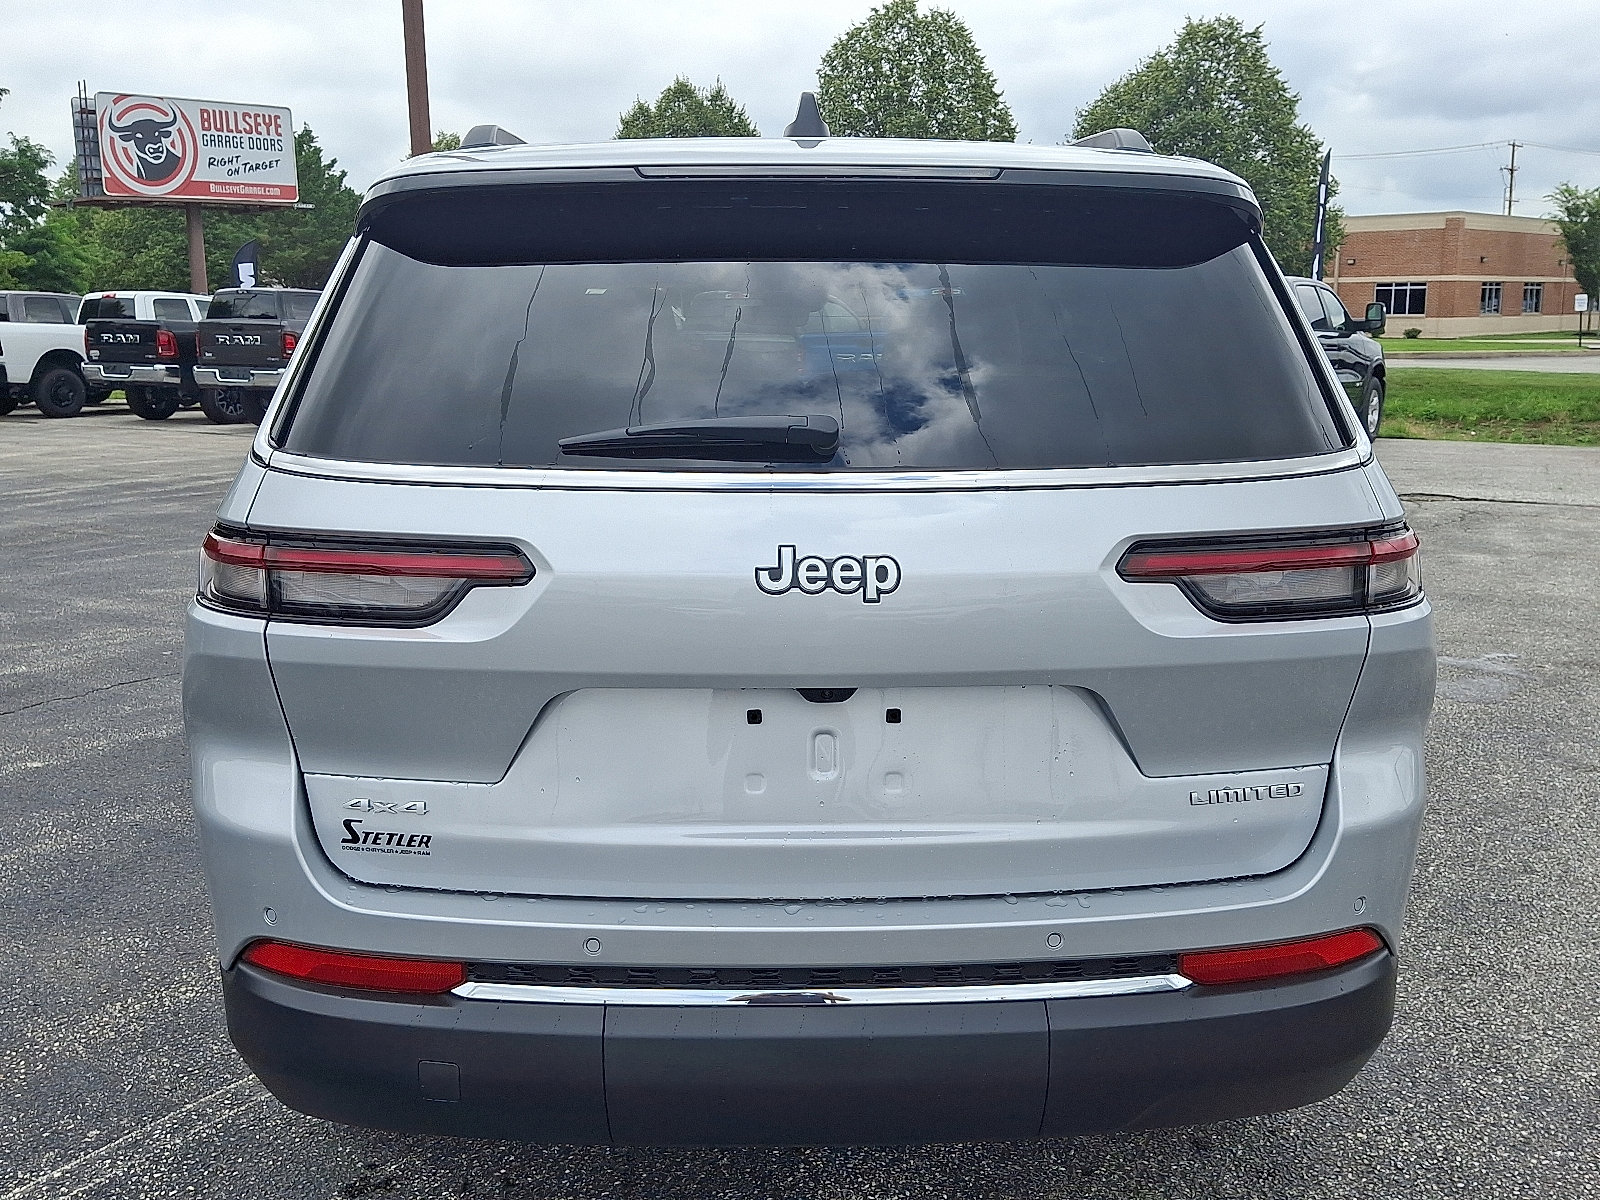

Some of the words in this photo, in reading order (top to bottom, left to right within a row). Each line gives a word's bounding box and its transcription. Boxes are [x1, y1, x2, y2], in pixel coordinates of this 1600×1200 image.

[199, 108, 283, 137] BULLSEYE
[201, 133, 245, 149] GARAGE
[248, 136, 284, 152] DOORS
[208, 155, 241, 169] RIGHT
[227, 167, 240, 176] ON
[242, 159, 281, 174] TARGET
[100, 333, 140, 344] RAM
[215, 334, 261, 346] RAM
[755, 544, 902, 604] Jeep
[1189, 782, 1304, 806] LIMITED
[340, 818, 433, 849] STETLER
[365, 846, 395, 854] CHRYSLER
